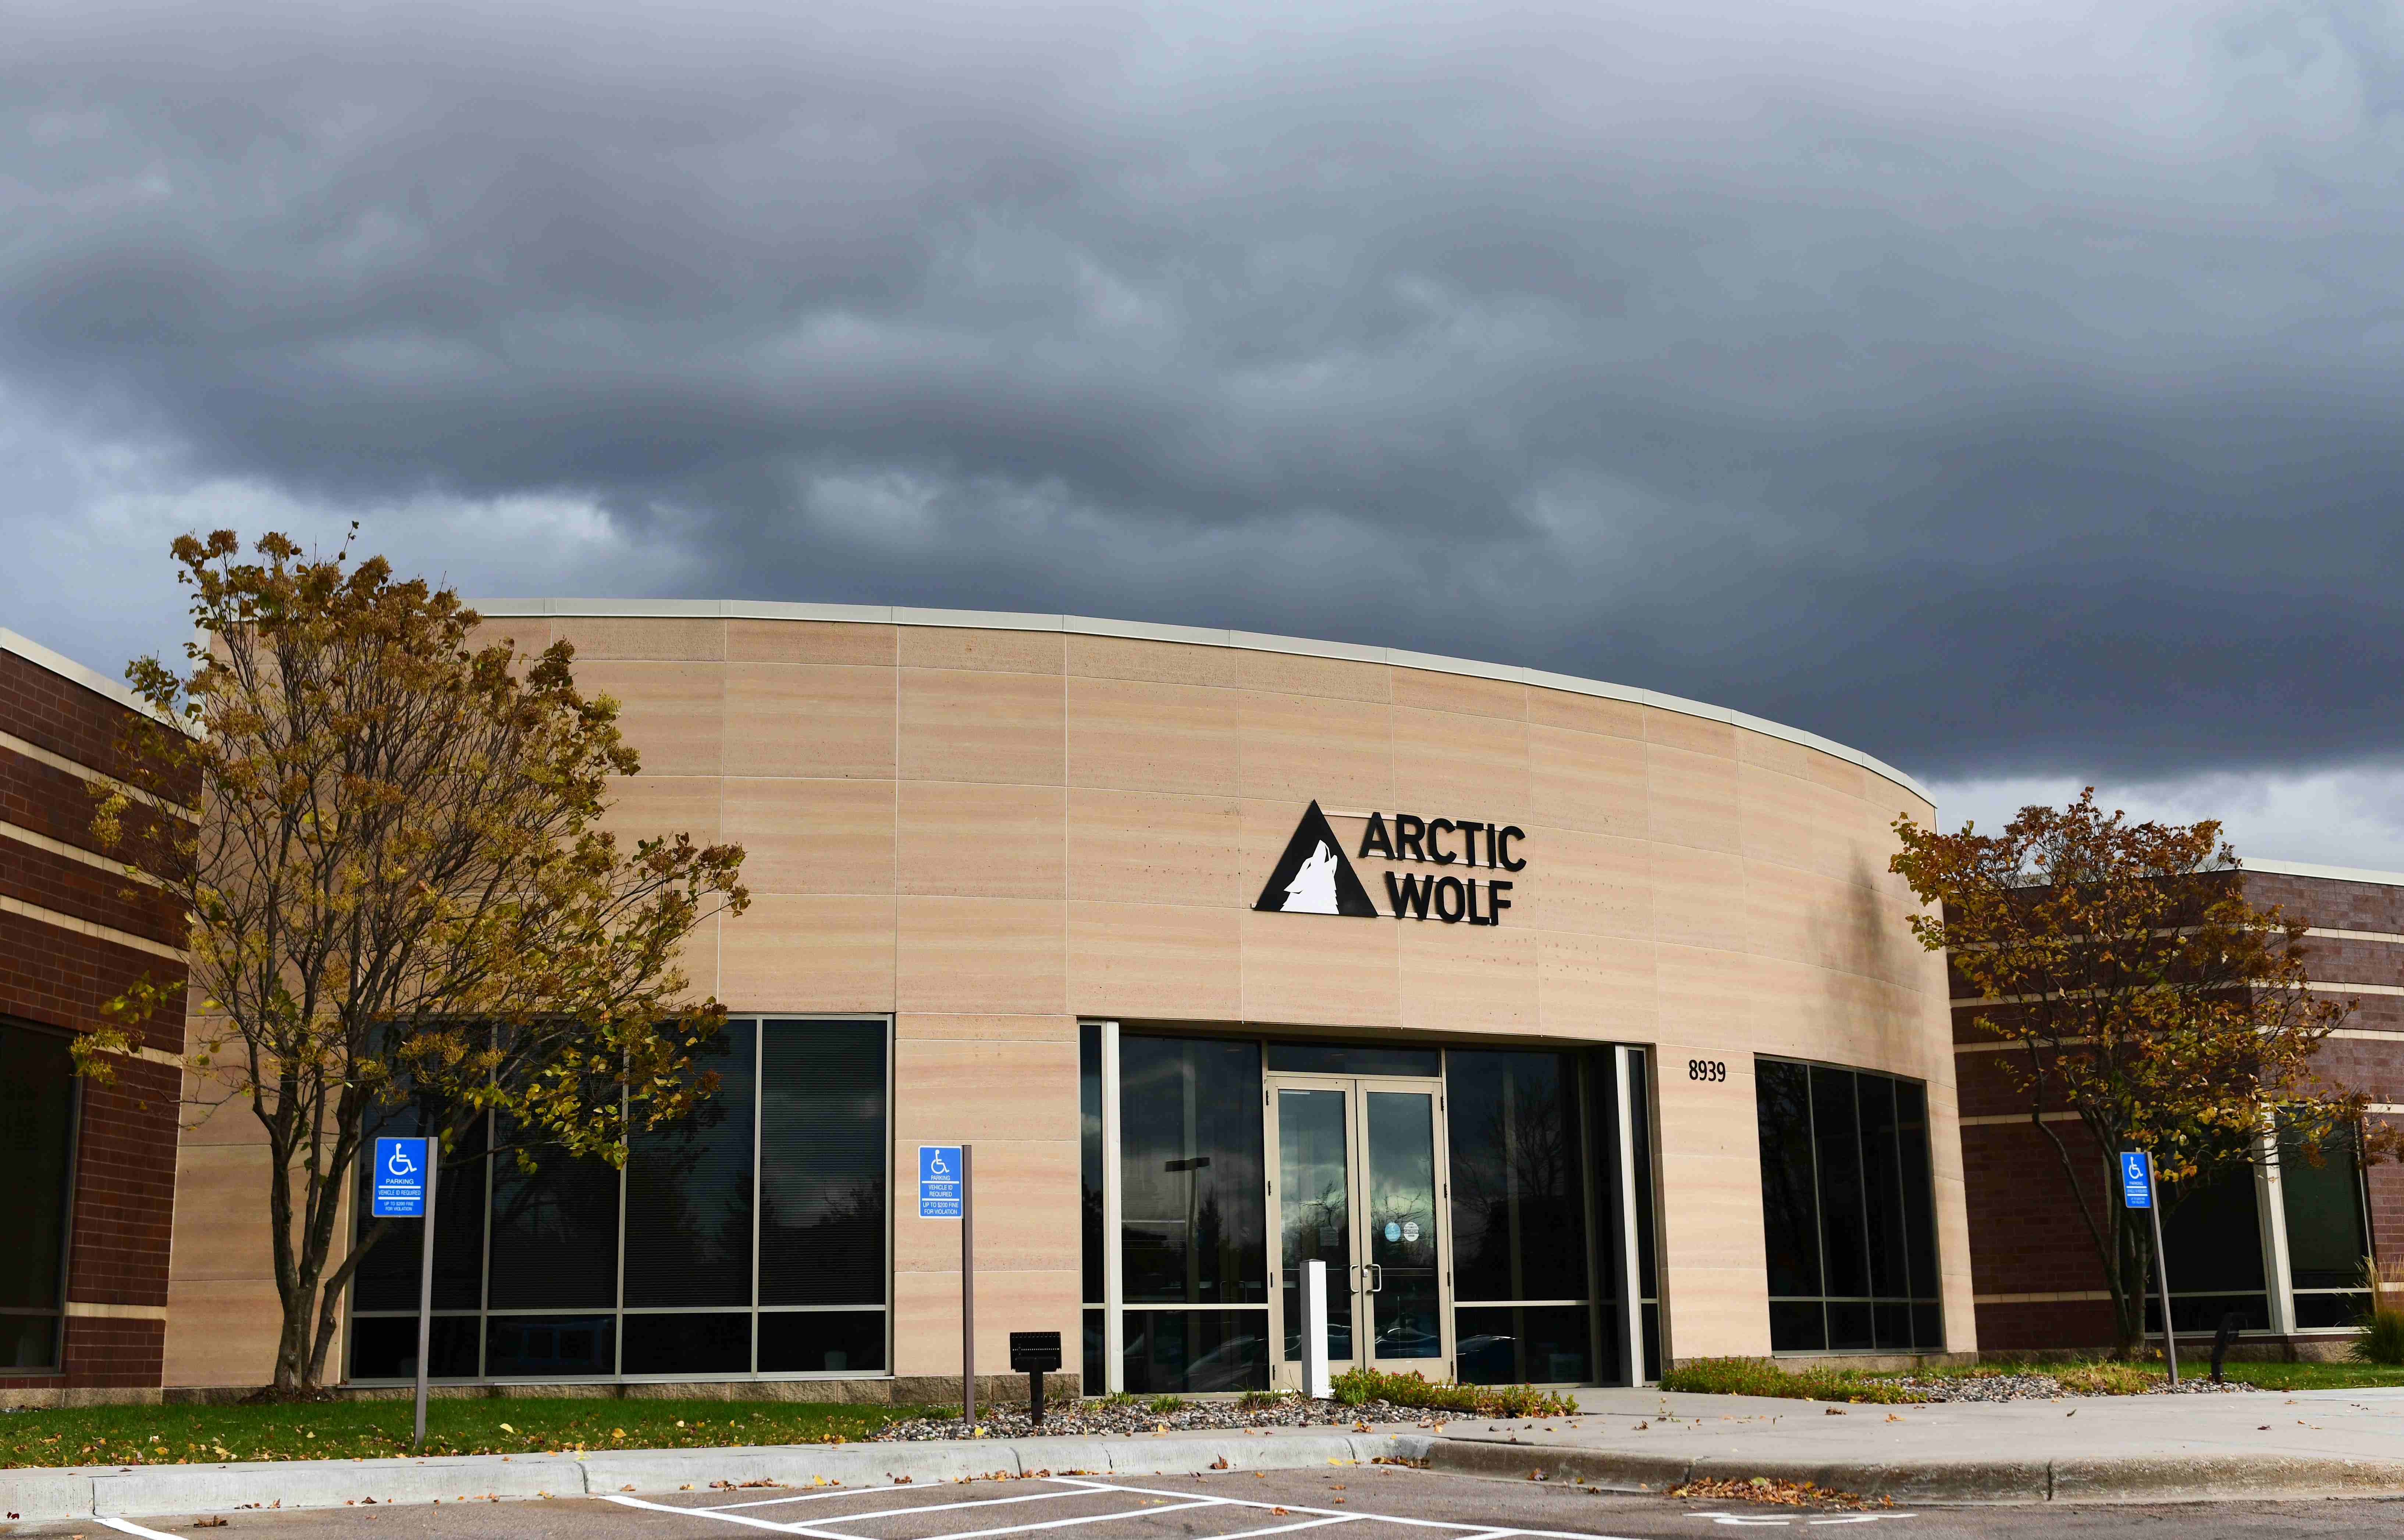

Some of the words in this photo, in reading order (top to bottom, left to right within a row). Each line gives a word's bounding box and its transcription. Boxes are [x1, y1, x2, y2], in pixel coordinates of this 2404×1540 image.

[1358, 812, 1527, 871] ARCTIC
[1385, 871, 1513, 926] WOLF
[1689, 1059, 1726, 1082] 8939
